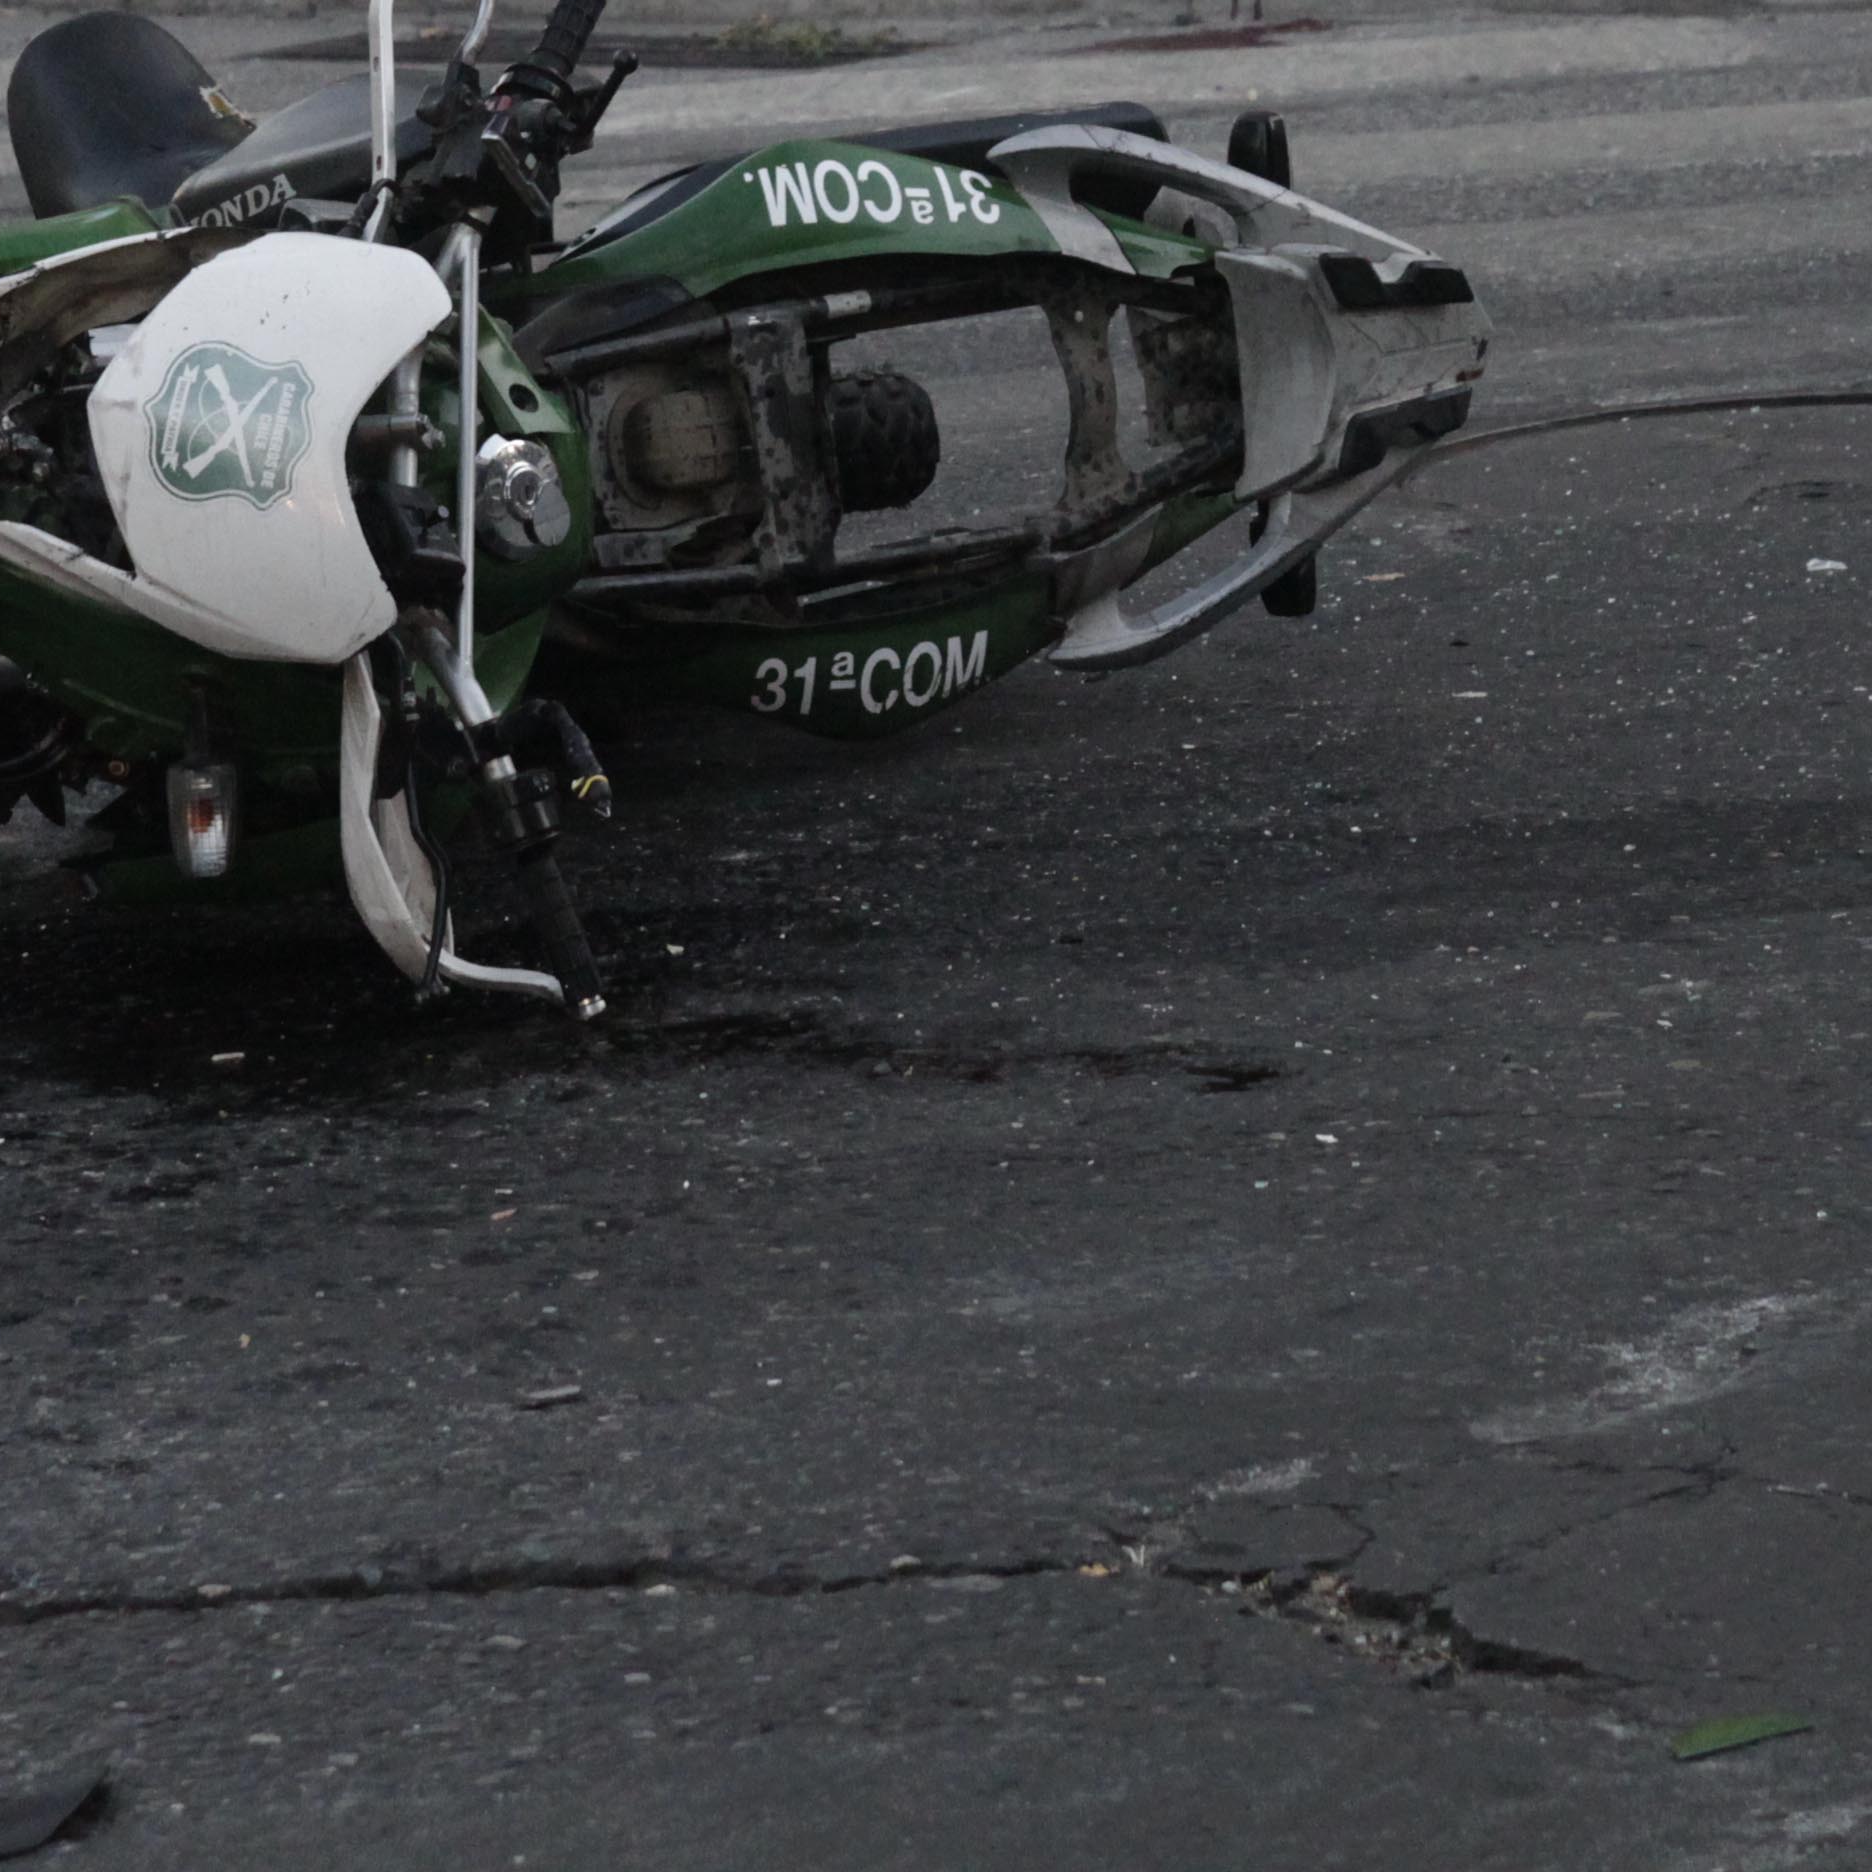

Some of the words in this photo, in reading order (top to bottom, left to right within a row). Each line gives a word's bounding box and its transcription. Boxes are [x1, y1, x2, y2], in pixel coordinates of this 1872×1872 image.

[254, 414, 273, 450] CHILE
[266, 382, 296, 467] CARABINEROS
[260, 469, 277, 489] DE
